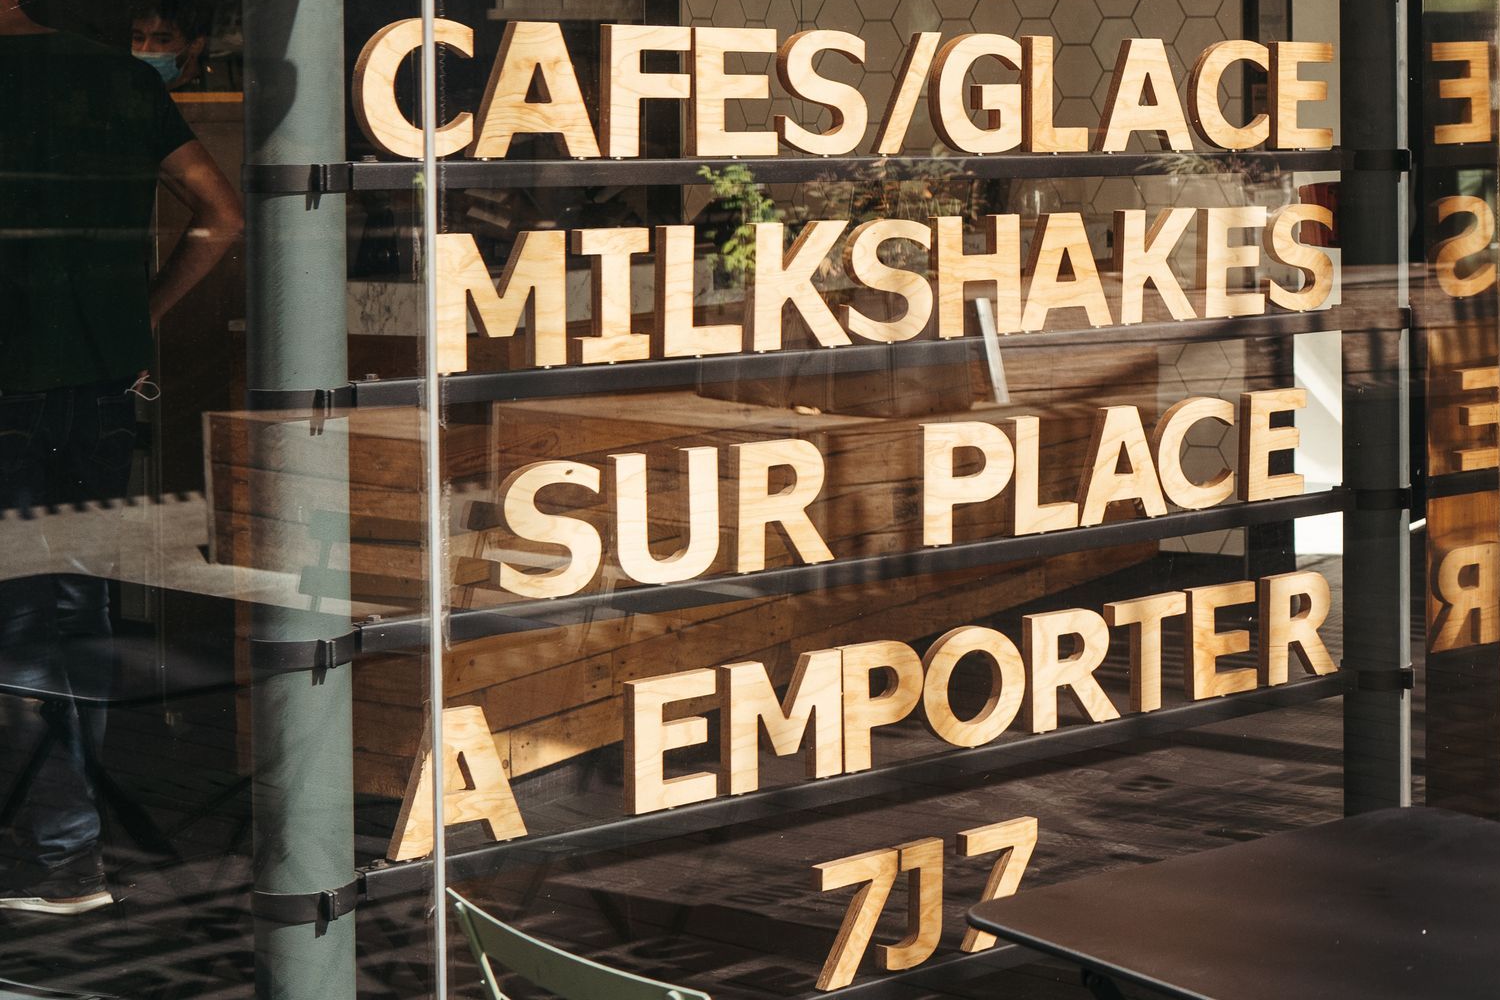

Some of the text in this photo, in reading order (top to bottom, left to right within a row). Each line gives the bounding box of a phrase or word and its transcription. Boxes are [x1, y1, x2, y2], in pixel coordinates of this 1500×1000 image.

[352, 15, 1335, 160] CAFES/GLACE
[433, 202, 1337, 374] MILKSHAKES
[497, 387, 1307, 599] SUR PLACE
[385, 569, 1340, 862] A EMPORTER
